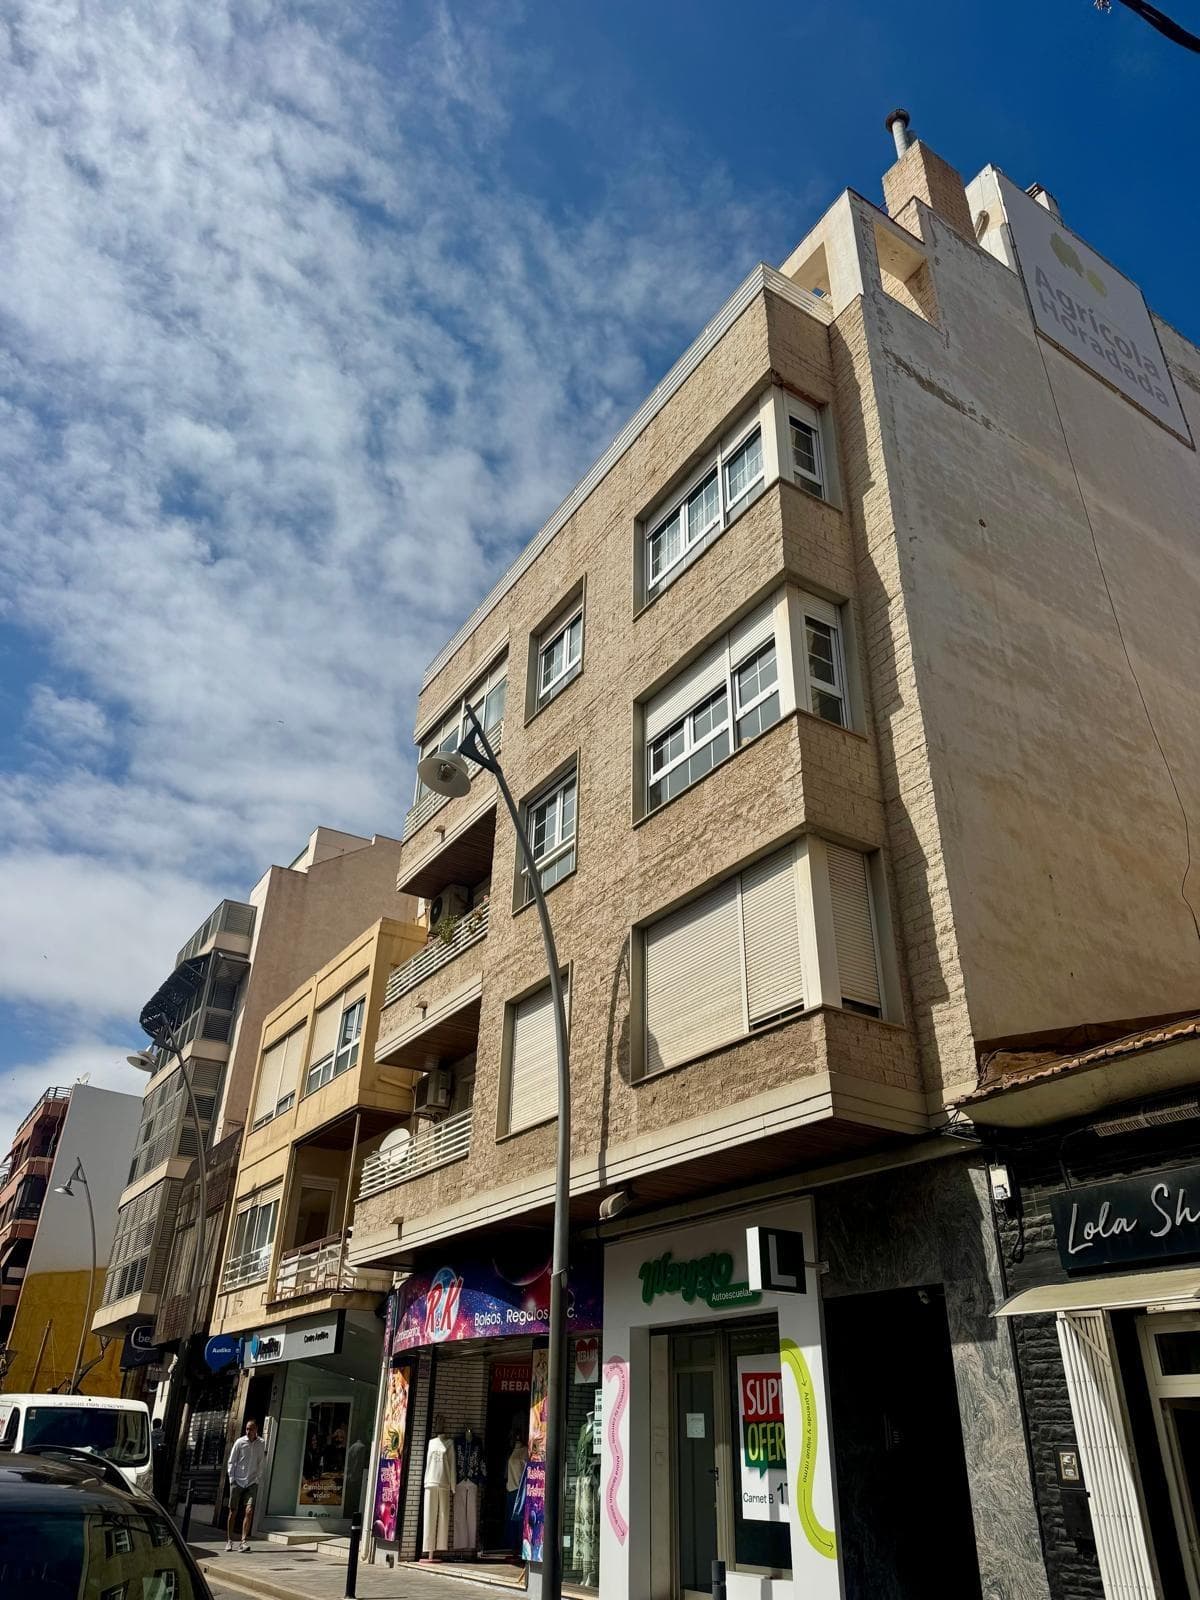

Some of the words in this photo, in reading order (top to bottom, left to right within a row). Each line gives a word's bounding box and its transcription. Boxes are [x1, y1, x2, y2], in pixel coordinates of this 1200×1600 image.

[1037, 290, 1170, 408] Horadada
[1068, 1201, 1138, 1254] Lola
[767, 1233, 797, 1288] L
[711, 1287, 753, 1303] Autoescuelas
[743, 1491, 768, 1504] Carnet
[768, 1493, 775, 1504] B
